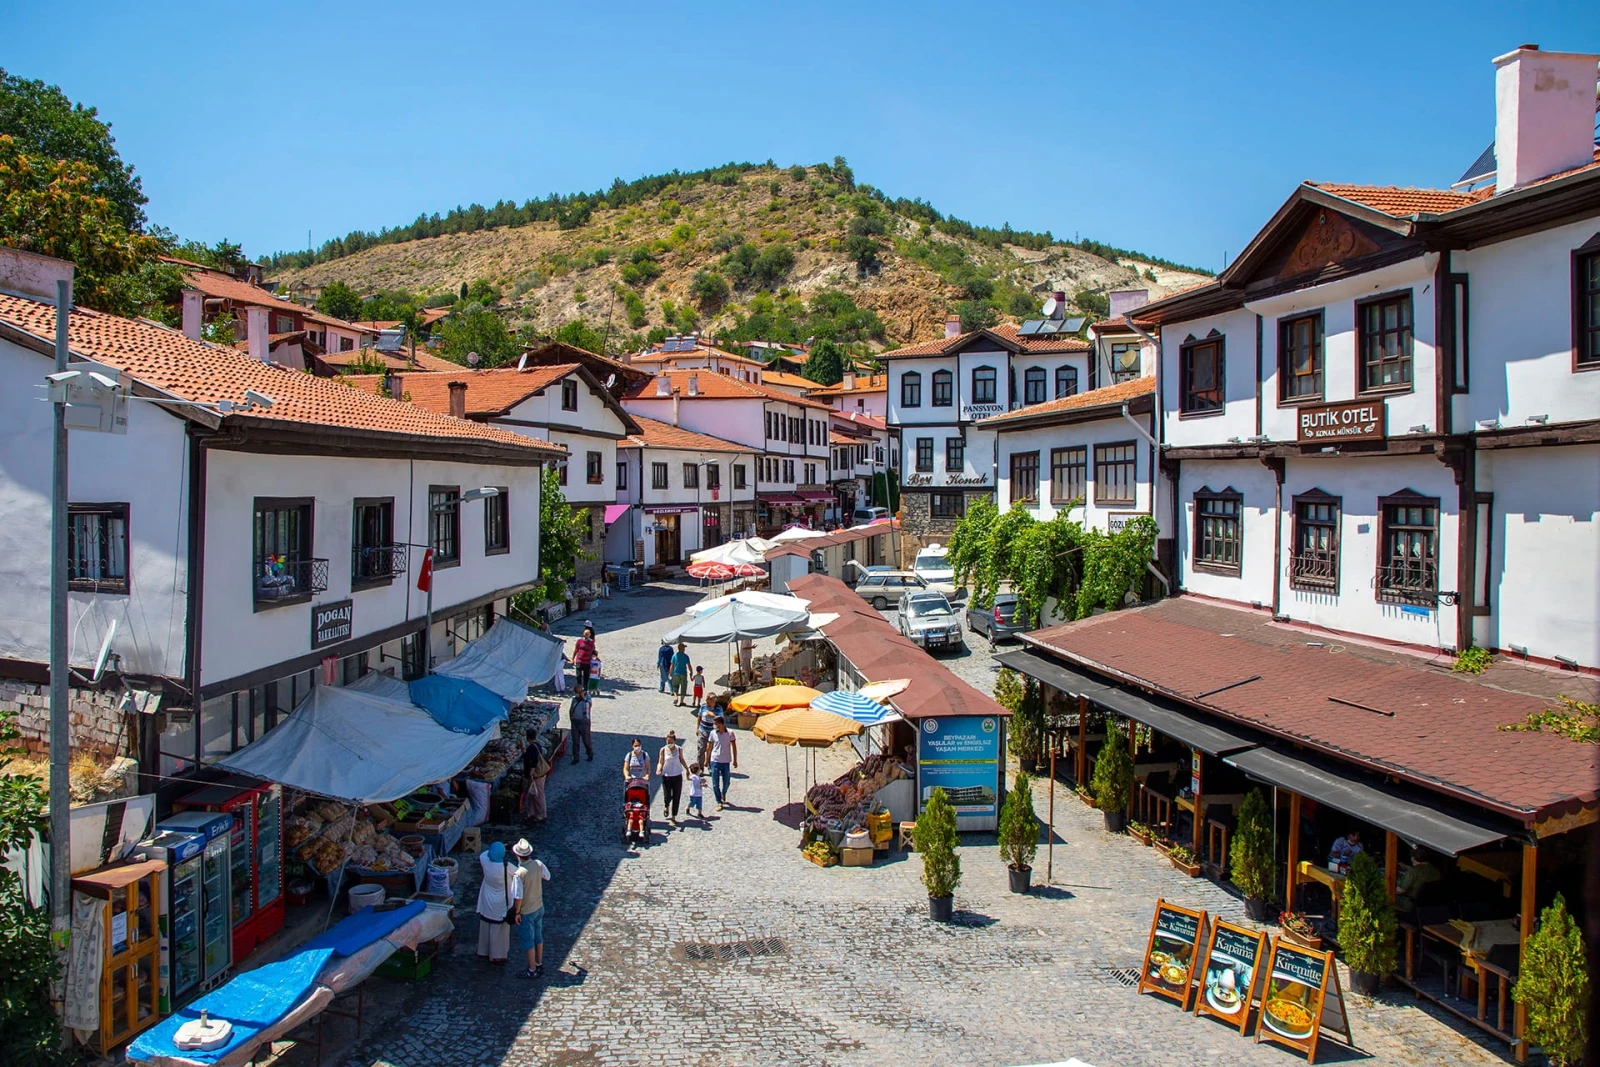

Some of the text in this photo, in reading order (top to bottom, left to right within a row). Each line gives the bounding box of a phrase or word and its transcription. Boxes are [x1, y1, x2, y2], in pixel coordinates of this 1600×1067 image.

[1301, 407, 1379, 428] BUTİK OTEL
[1315, 428, 1336, 438] KONAK
[907, 472, 989, 487] Bey Konak
[1157, 918, 1169, 929] Sac
[1215, 936, 1255, 961] Kapama
[1275, 955, 1322, 981] Kiremitte
